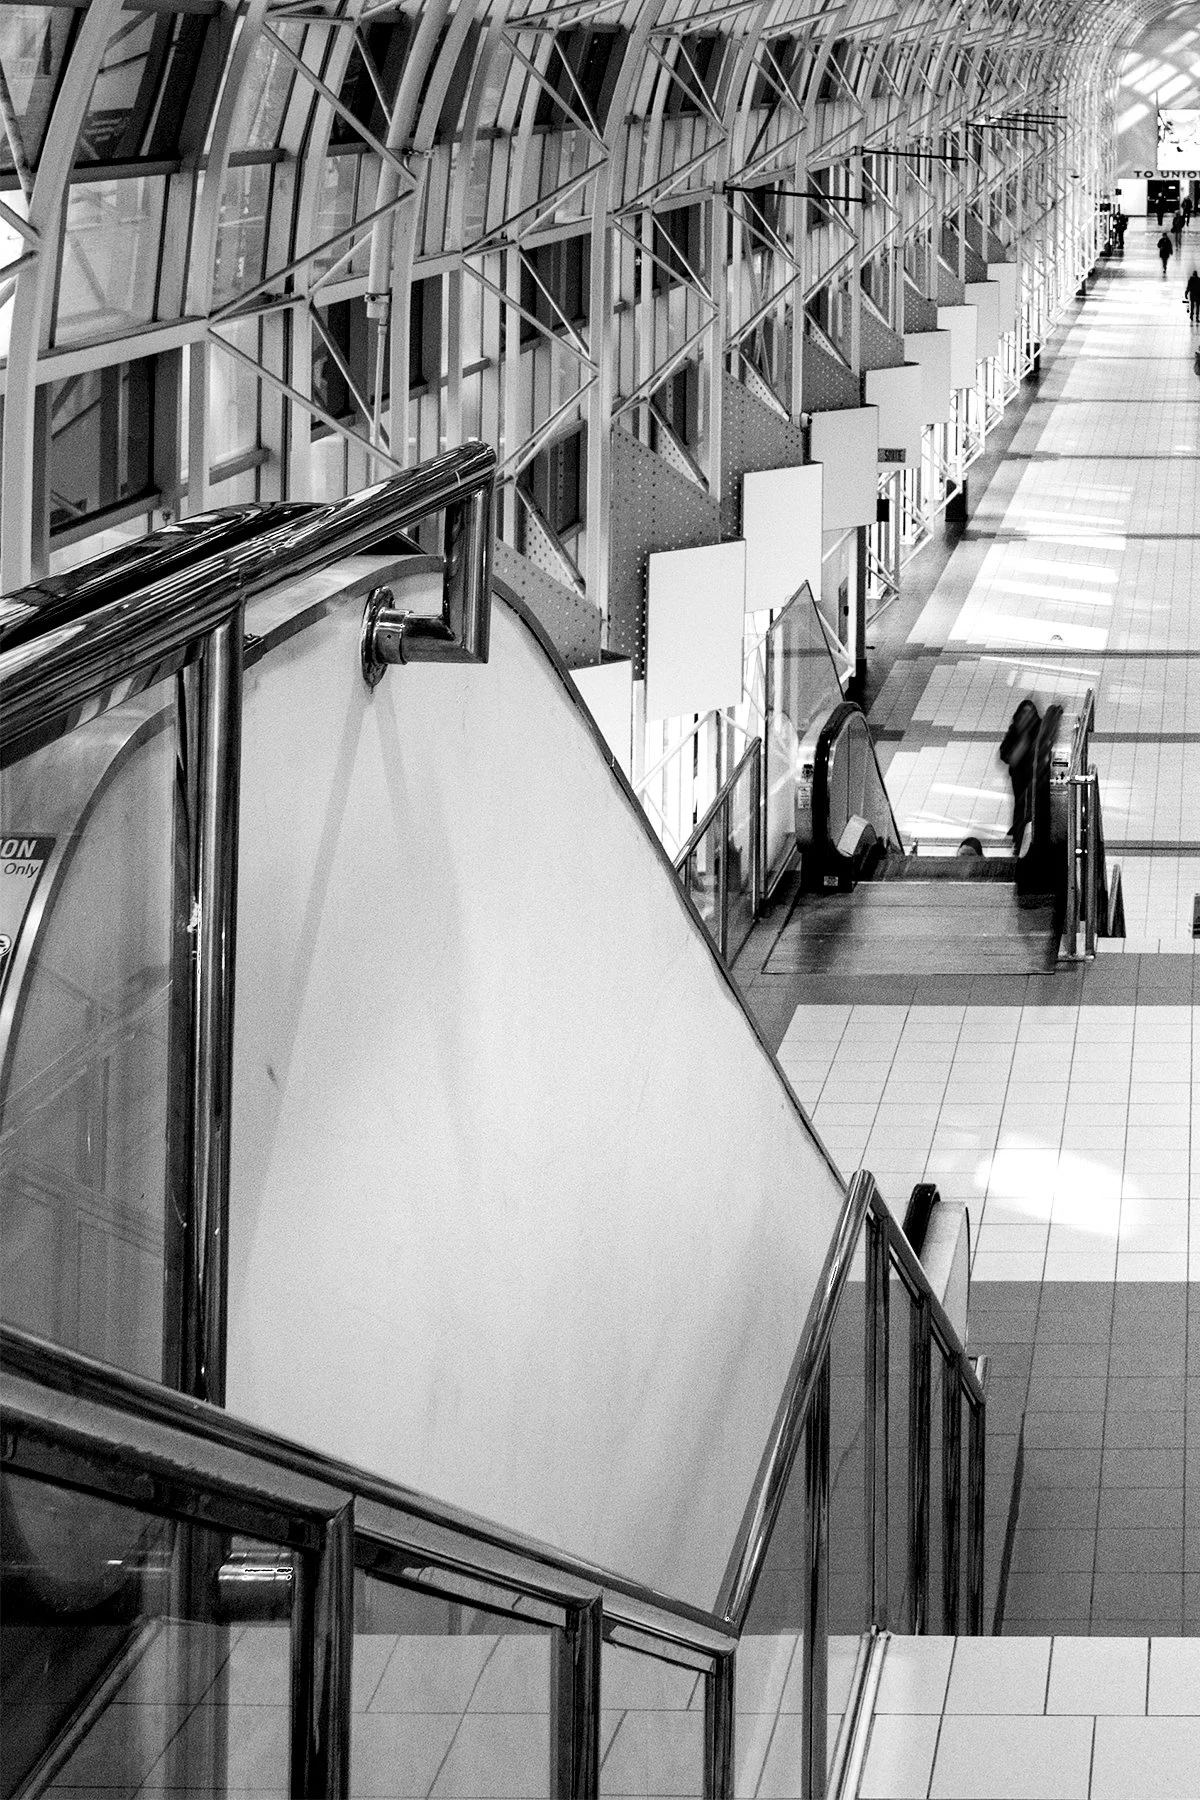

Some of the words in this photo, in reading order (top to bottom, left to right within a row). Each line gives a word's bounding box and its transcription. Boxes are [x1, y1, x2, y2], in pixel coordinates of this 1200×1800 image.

[1133, 170, 1154, 179] TO
[0, 840, 37, 857] ON
[4, 863, 38, 878] Only
